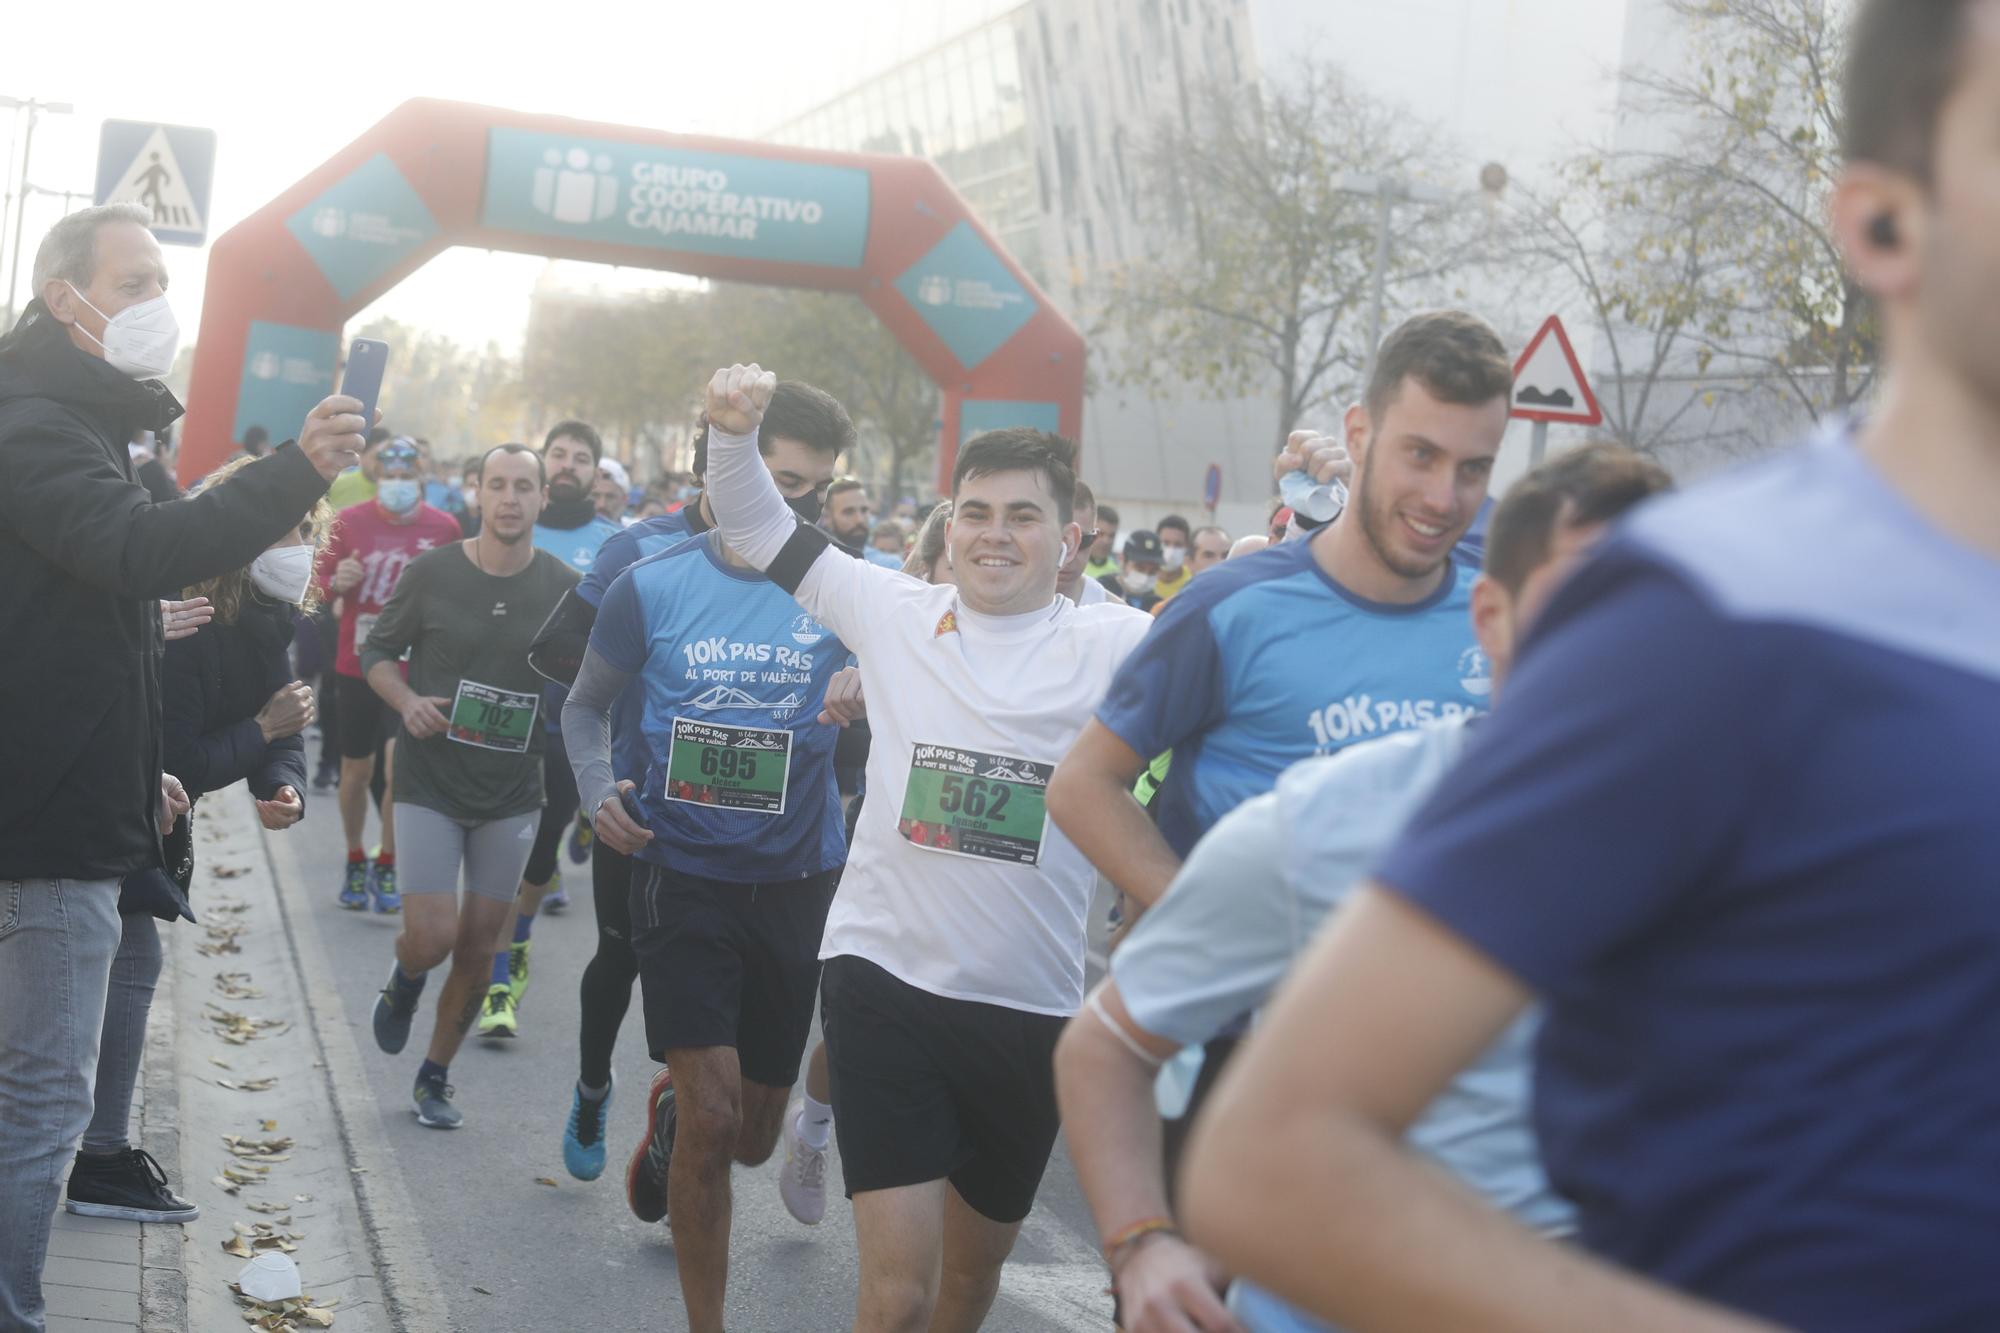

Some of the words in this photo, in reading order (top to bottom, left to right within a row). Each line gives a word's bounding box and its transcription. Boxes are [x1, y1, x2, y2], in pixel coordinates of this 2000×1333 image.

[631, 161, 728, 192] GRUPO
[629, 183, 823, 224] COOPERATIVO
[627, 207, 757, 240] CAJAMAR
[683, 636, 728, 667] 10K
[729, 642, 772, 662] PAS
[775, 646, 814, 671] RAS
[685, 669, 698, 680] AL
[703, 669, 736, 682] PORT
[741, 671, 756, 683] DE
[761, 667, 811, 684] VALÈNCIA
[478, 703, 514, 729] 702
[677, 723, 694, 734] 10K
[694, 726, 711, 736] PAS
[712, 730, 729, 741] RAS
[1307, 693, 1376, 745] 10K
[1375, 699, 1435, 731] PAS
[701, 746, 757, 781] 695
[916, 745, 936, 760] 10K
[935, 749, 956, 761] PAS
[957, 753, 978, 768] RAS
[939, 775, 1011, 822] 562
